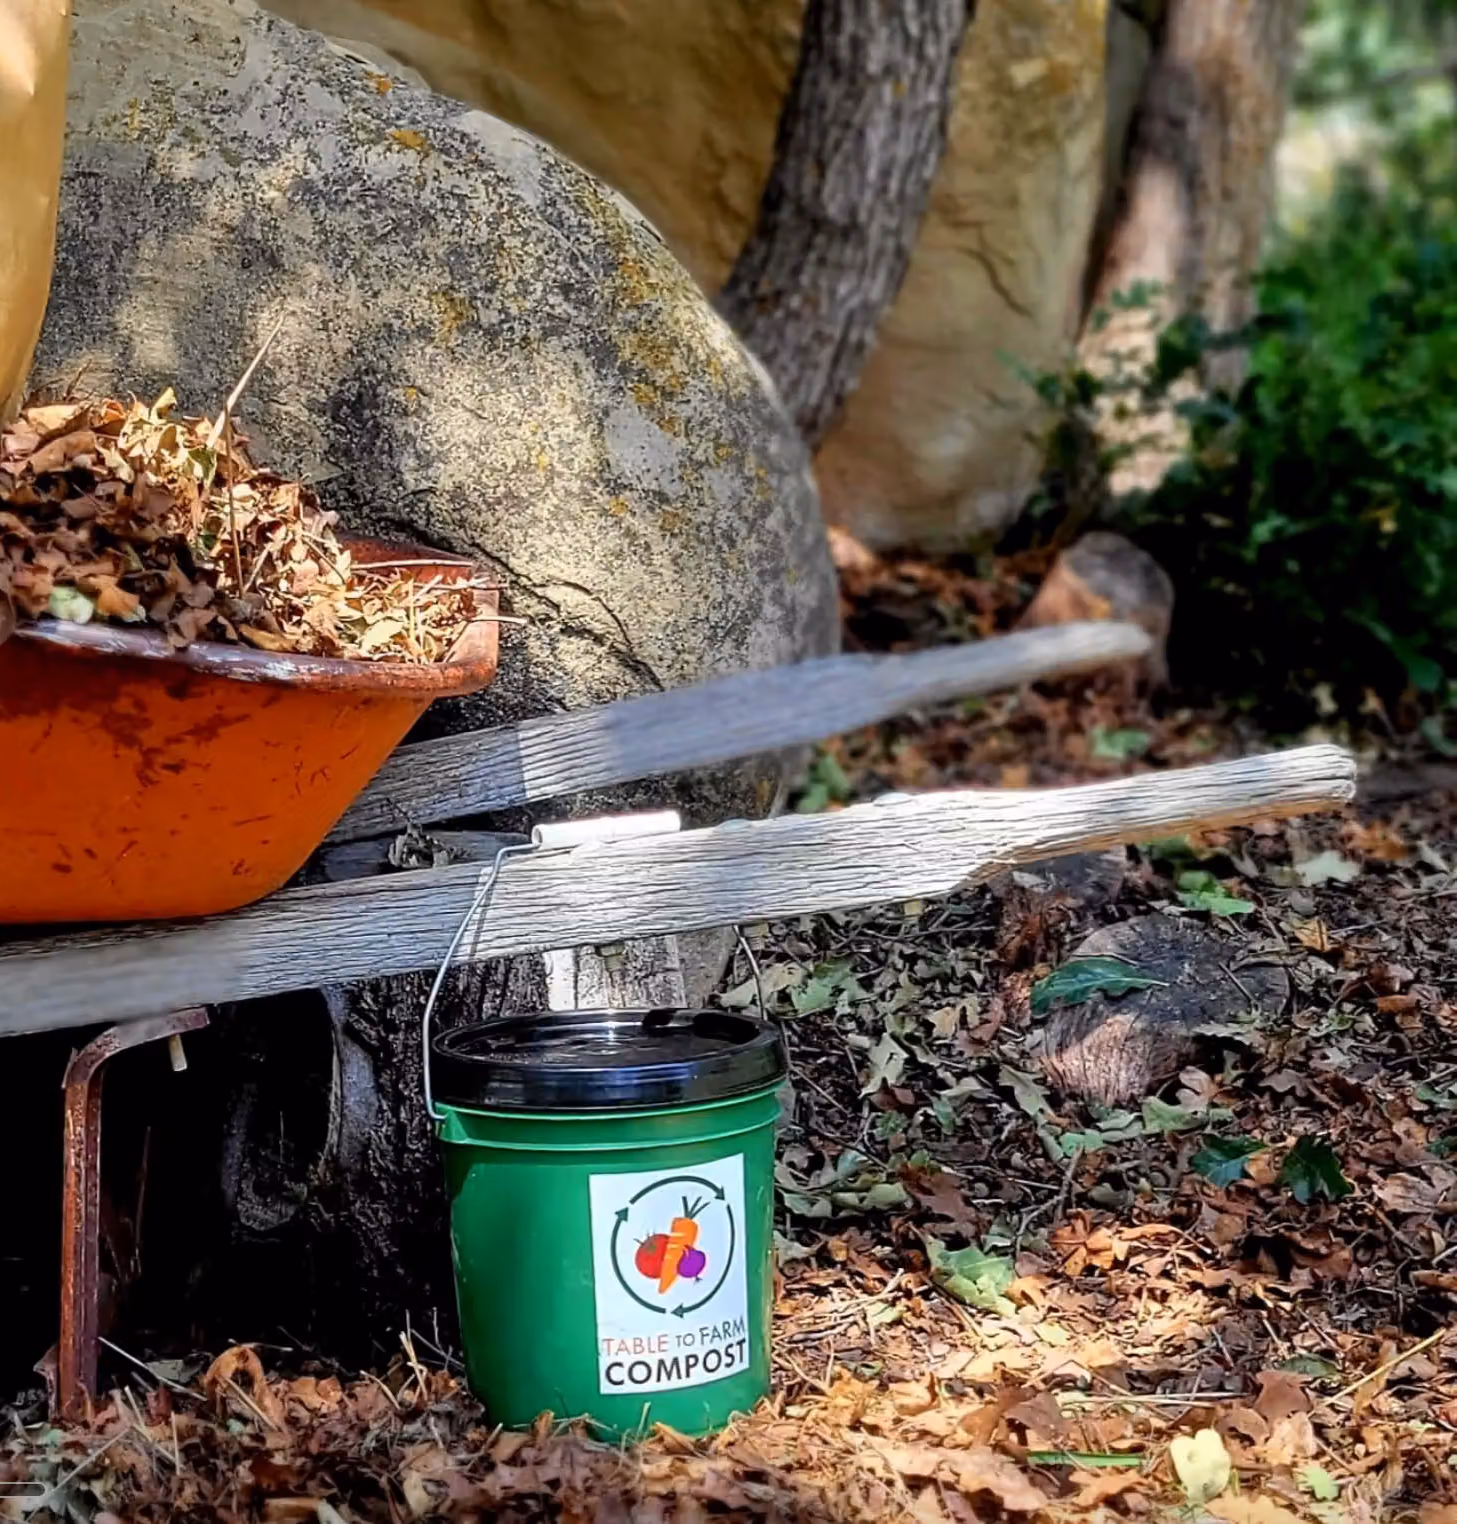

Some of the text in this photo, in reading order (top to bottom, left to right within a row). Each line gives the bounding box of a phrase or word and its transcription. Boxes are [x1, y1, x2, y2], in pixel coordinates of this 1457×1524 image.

[603, 1317, 745, 1356] TABLE TO FARM
[605, 1339, 746, 1386] COMPOST
